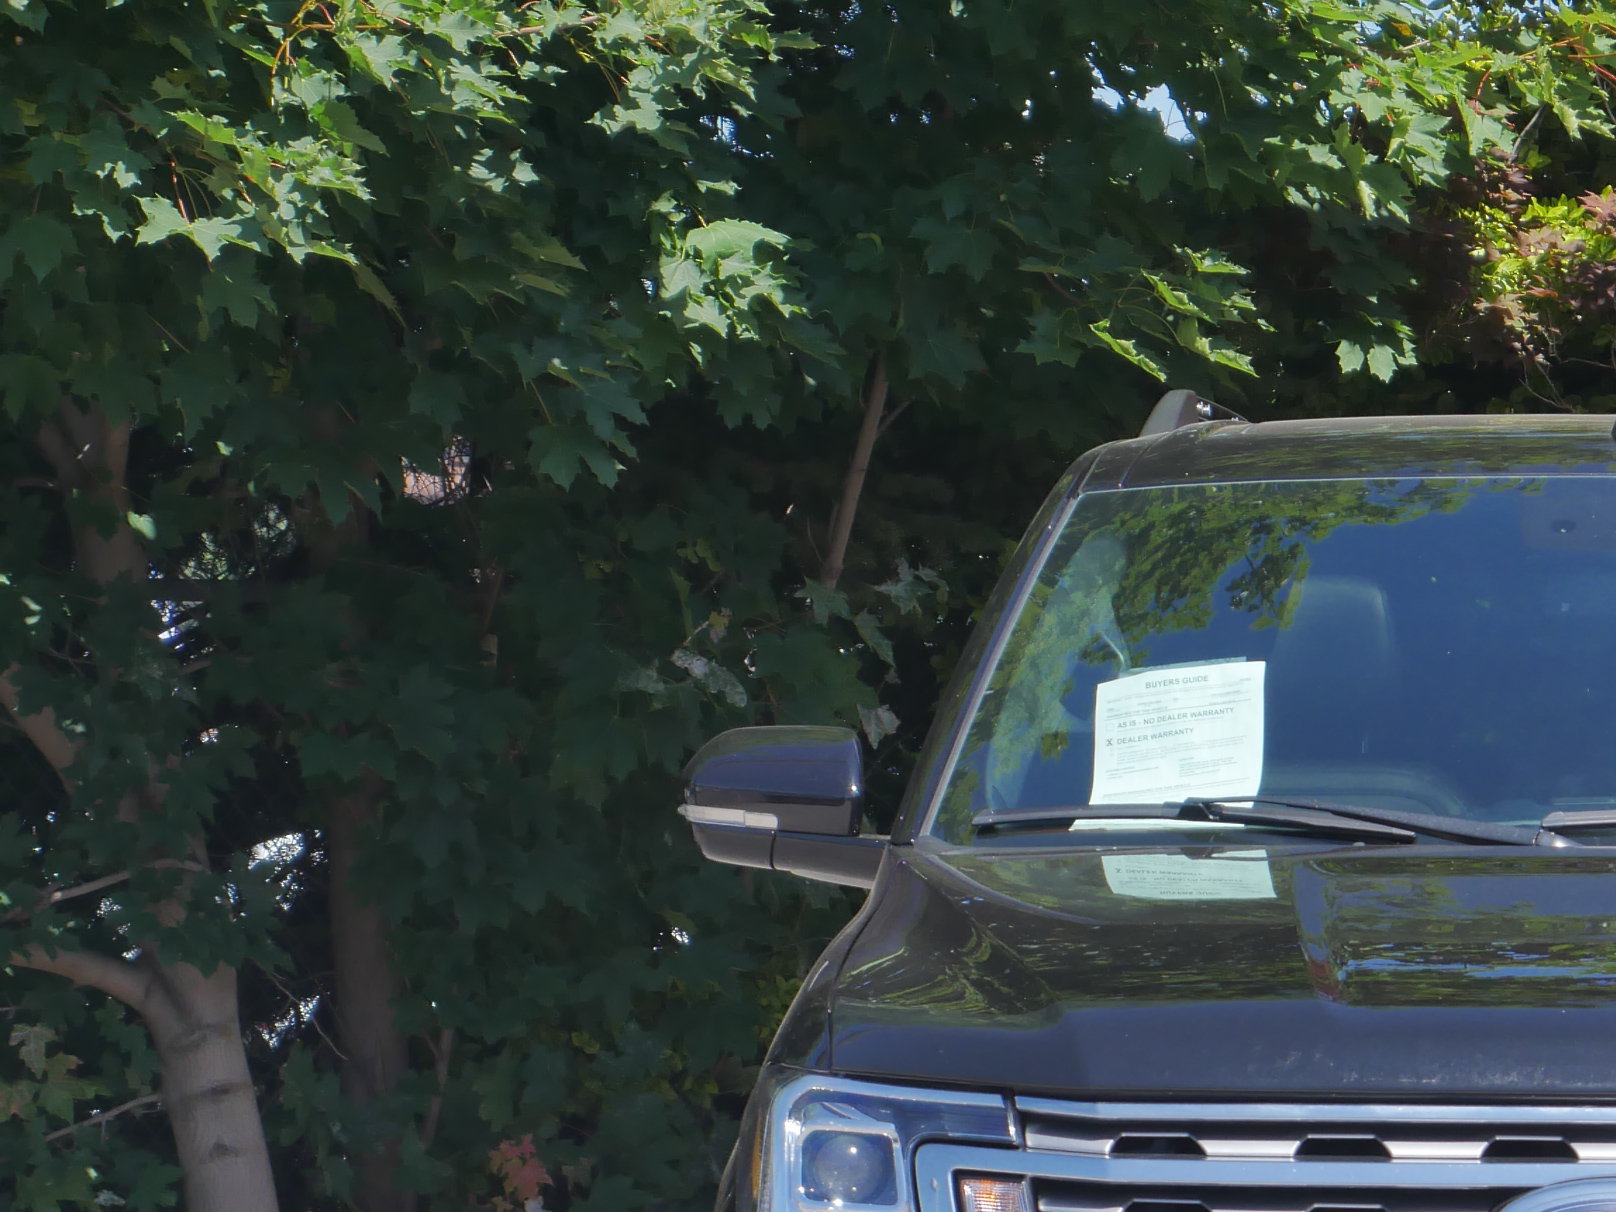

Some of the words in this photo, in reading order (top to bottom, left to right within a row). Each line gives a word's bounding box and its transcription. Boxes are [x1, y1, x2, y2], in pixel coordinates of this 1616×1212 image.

[1145, 678, 1180, 689] BUYERS
[1182, 675, 1209, 685] GUIDE
[1143, 717, 1156, 725] NO
[1157, 712, 1188, 723] DEALER
[1190, 707, 1235, 719] WARRANTY
[1116, 734, 1148, 745] DEALER
[1150, 728, 1194, 740] WARRANTY
